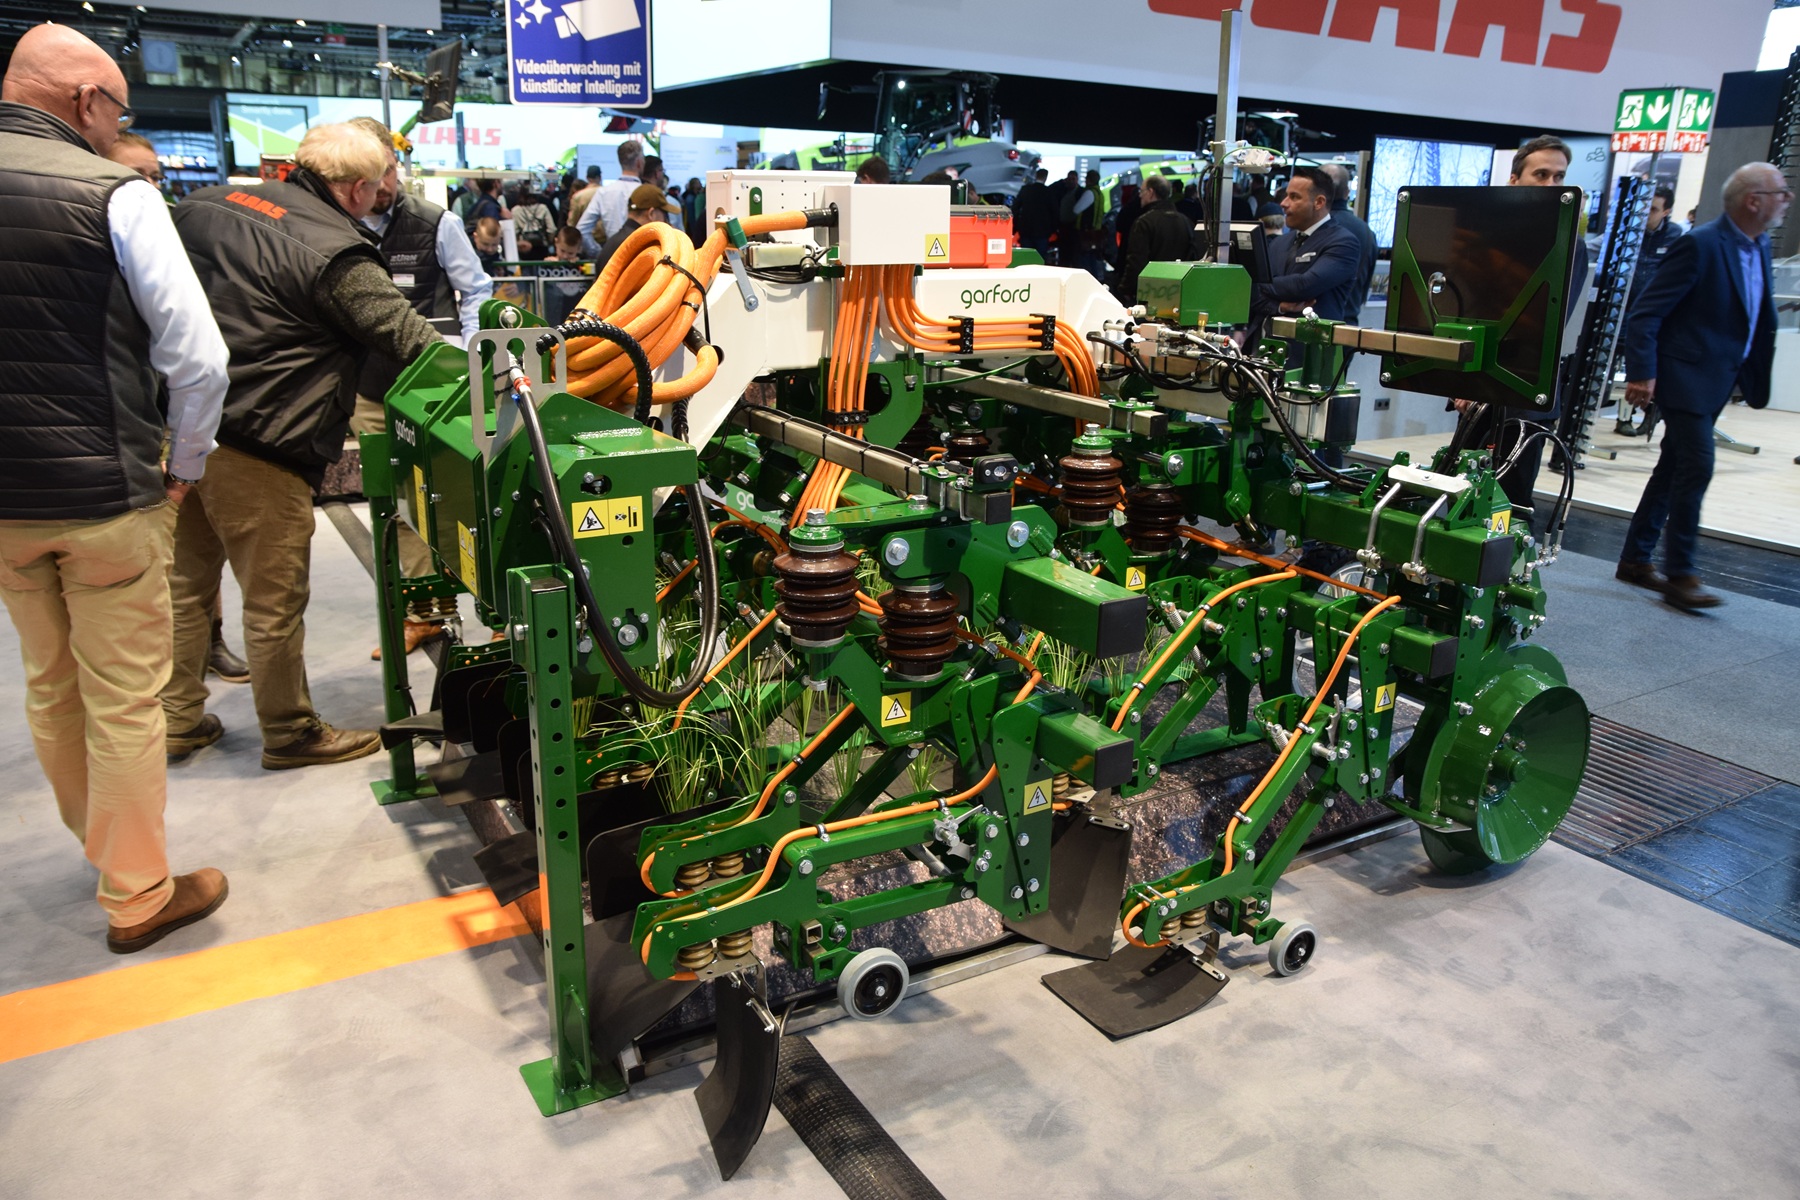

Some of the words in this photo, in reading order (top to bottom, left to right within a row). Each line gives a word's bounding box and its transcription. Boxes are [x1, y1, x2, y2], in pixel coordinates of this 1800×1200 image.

[1148, 0, 1622, 74] AAS
[515, 58, 621, 79] Videoüberwachung
[623, 61, 642, 76] mit
[520, 77, 583, 94] künstlicher
[585, 79, 641, 98] Intelligenz
[405, 126, 502, 146] LAAS
[225, 191, 289, 220] CLAAS
[960, 283, 1031, 309] garford
[395, 419, 416, 447] garford
